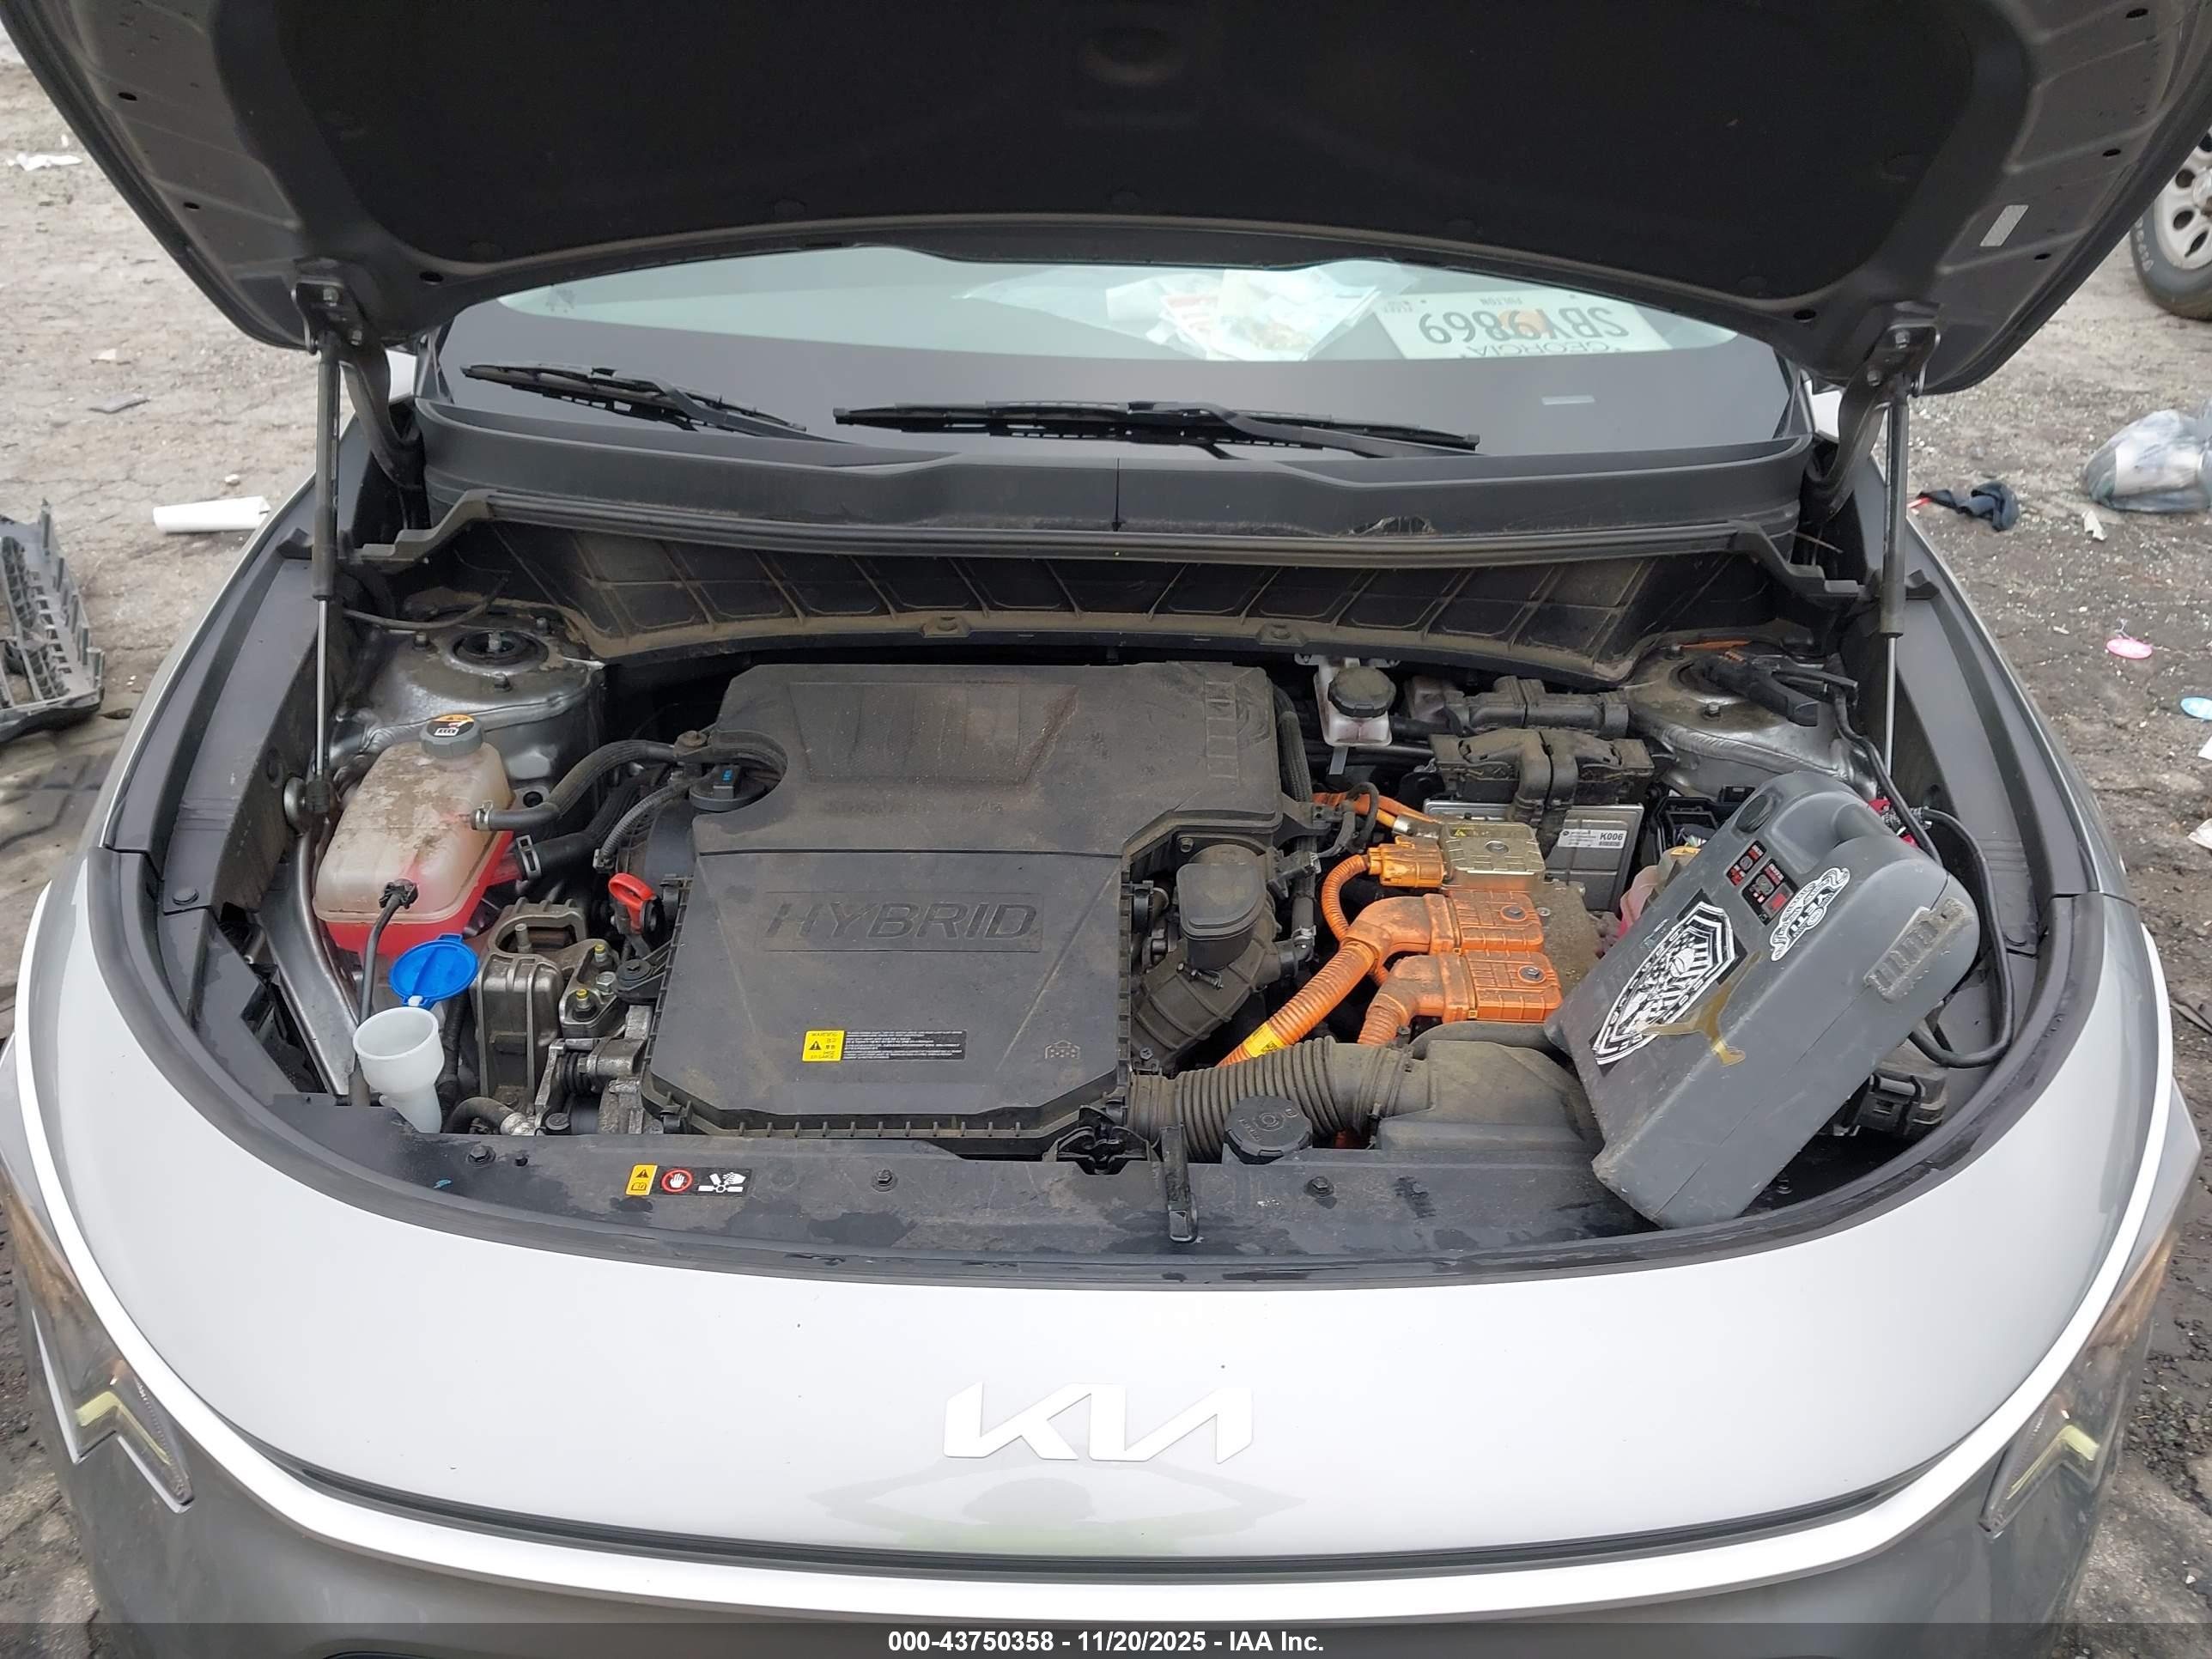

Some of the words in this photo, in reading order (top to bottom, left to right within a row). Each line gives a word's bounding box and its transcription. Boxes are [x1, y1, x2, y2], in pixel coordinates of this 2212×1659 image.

[1418, 307, 1630, 344] SBY9869
[1466, 341, 1611, 357] GEORGIA
[1600, 832, 1624, 841] K006
[764, 902, 1038, 939] HYBRID
[1790, 892, 1829, 932] YETI
[943, 1381, 1255, 1465] KIA
